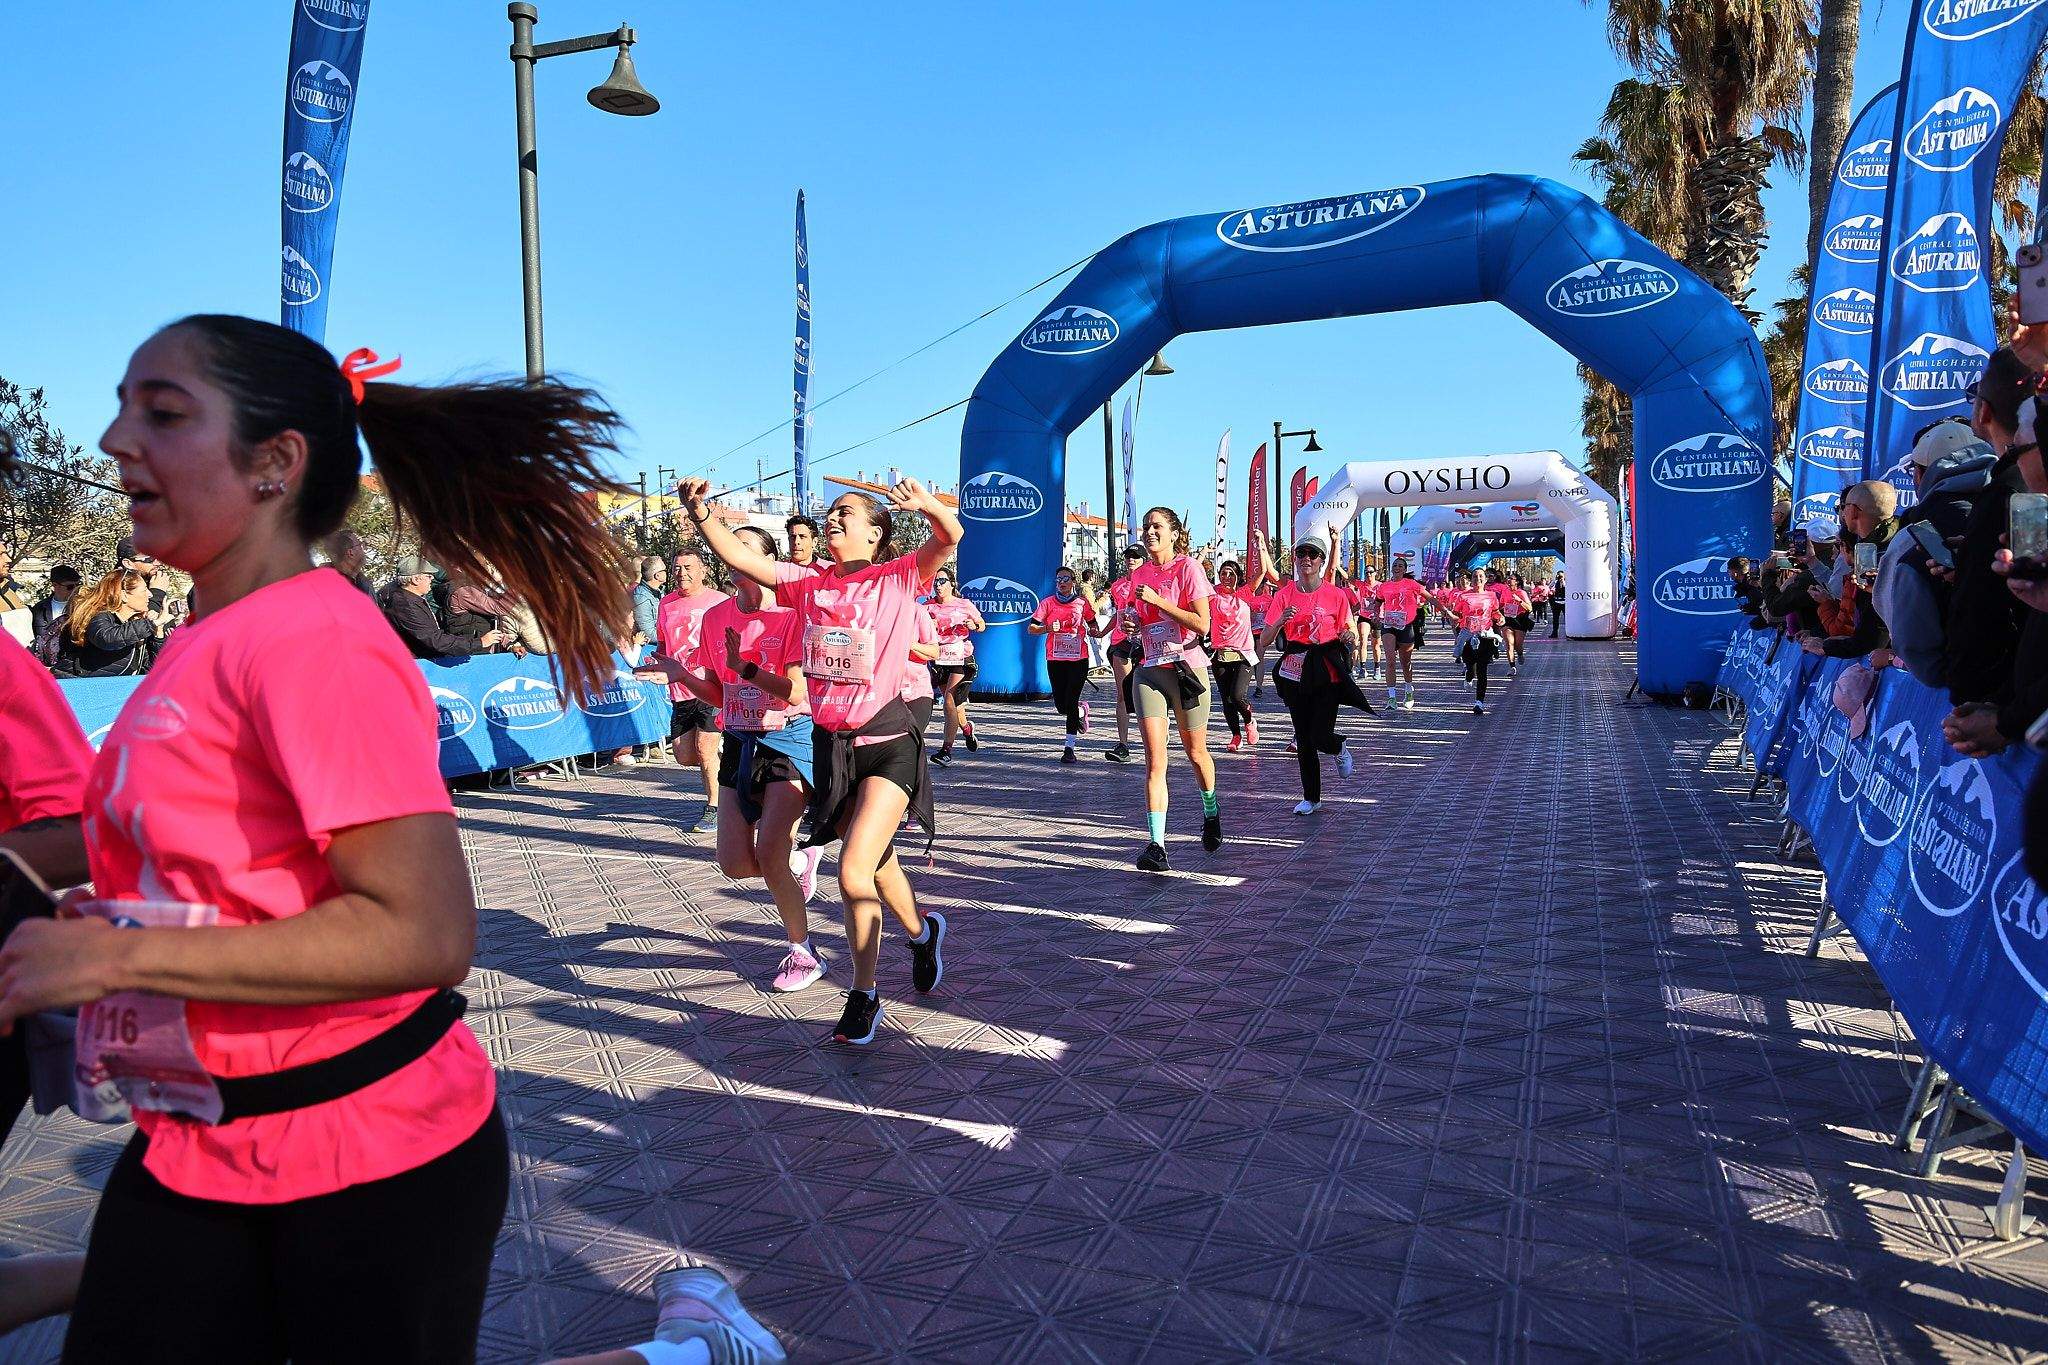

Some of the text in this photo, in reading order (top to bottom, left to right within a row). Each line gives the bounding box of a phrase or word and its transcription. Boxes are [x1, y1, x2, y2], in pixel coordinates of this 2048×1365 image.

[294, 77, 348, 113] ASTURIANA
[1841, 159, 1890, 178] ASTURI
[1229, 193, 1409, 239] ASTURIANA
[1829, 231, 1881, 250] ASTURIA
[1621, 273, 1664, 282] LECHERA
[1557, 280, 1670, 308] ASTURIANA
[1819, 302, 1874, 325] ASTURIAN
[1025, 327, 1111, 345] ASTURIANA
[1810, 373, 1868, 393] ASTURIA
[1675, 453, 1719, 461] CENTRAL
[1803, 439, 1862, 460] ASTURIA
[1658, 459, 1762, 480] ASTURIANA
[1384, 464, 1510, 494] OYSHO
[962, 491, 1037, 509] ASTURIANA
[1548, 487, 1589, 498] OYSHO
[1313, 501, 1348, 509] OYSHO
[1484, 536, 1548, 544] VOLVO
[1571, 540, 1605, 549] OYSH
[1571, 591, 1609, 601] OYSHO
[1660, 580, 1738, 600] ASTURI
[971, 600, 1033, 614] TURIANA
[825, 656, 851, 669] 016
[743, 708, 765, 719] 016
[2001, 877, 2048, 940] AS
